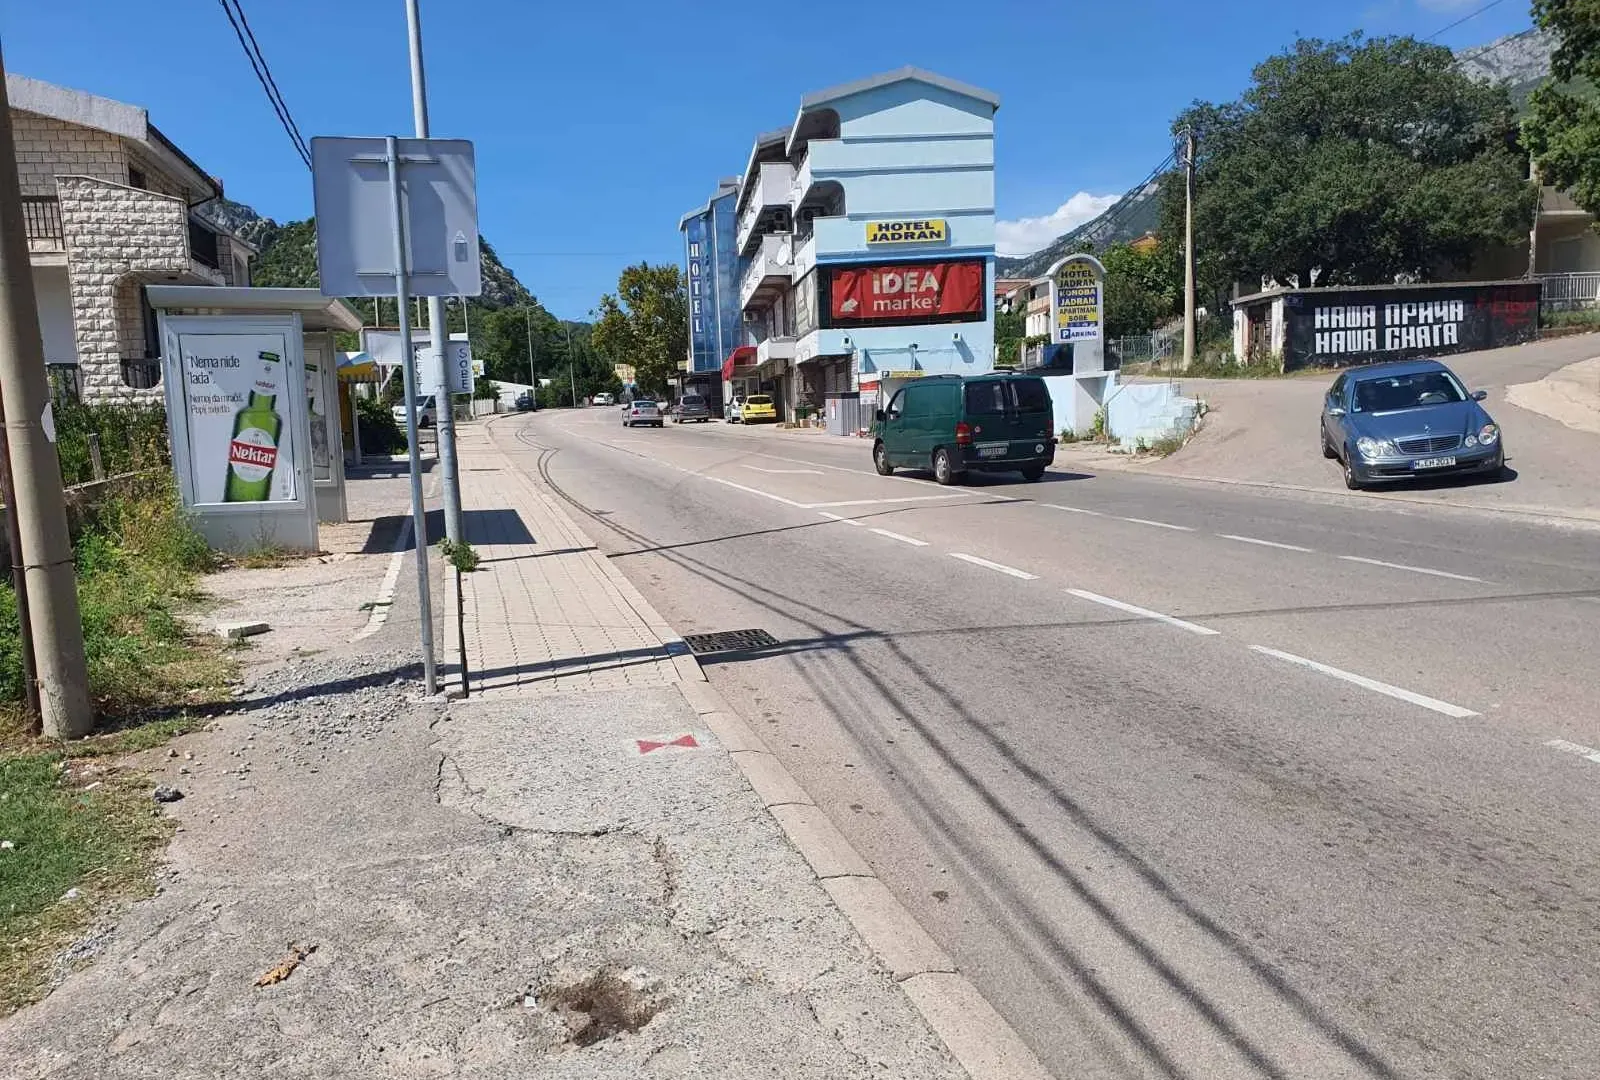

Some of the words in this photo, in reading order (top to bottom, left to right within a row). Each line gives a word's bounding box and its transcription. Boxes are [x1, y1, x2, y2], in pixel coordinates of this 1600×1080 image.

[878, 221, 934, 232] HOTEL
[870, 230, 942, 241] JADRAN
[1061, 270, 1094, 278] HOTEL
[690, 243, 702, 333] HOTEL
[1059, 279, 1095, 288] JADRAN
[1060, 298, 1095, 306] JADRAN
[1059, 306, 1097, 314] APARTMANI
[1314, 305, 1376, 329] НАША
[1385, 300, 1463, 326] ПРИЧА
[1068, 314, 1088, 322] SOBE
[1315, 328, 1377, 354] НАША
[1385, 322, 1458, 351] СНАГА
[190, 355, 219, 368] Nema
[232, 445, 275, 464] Nektar
